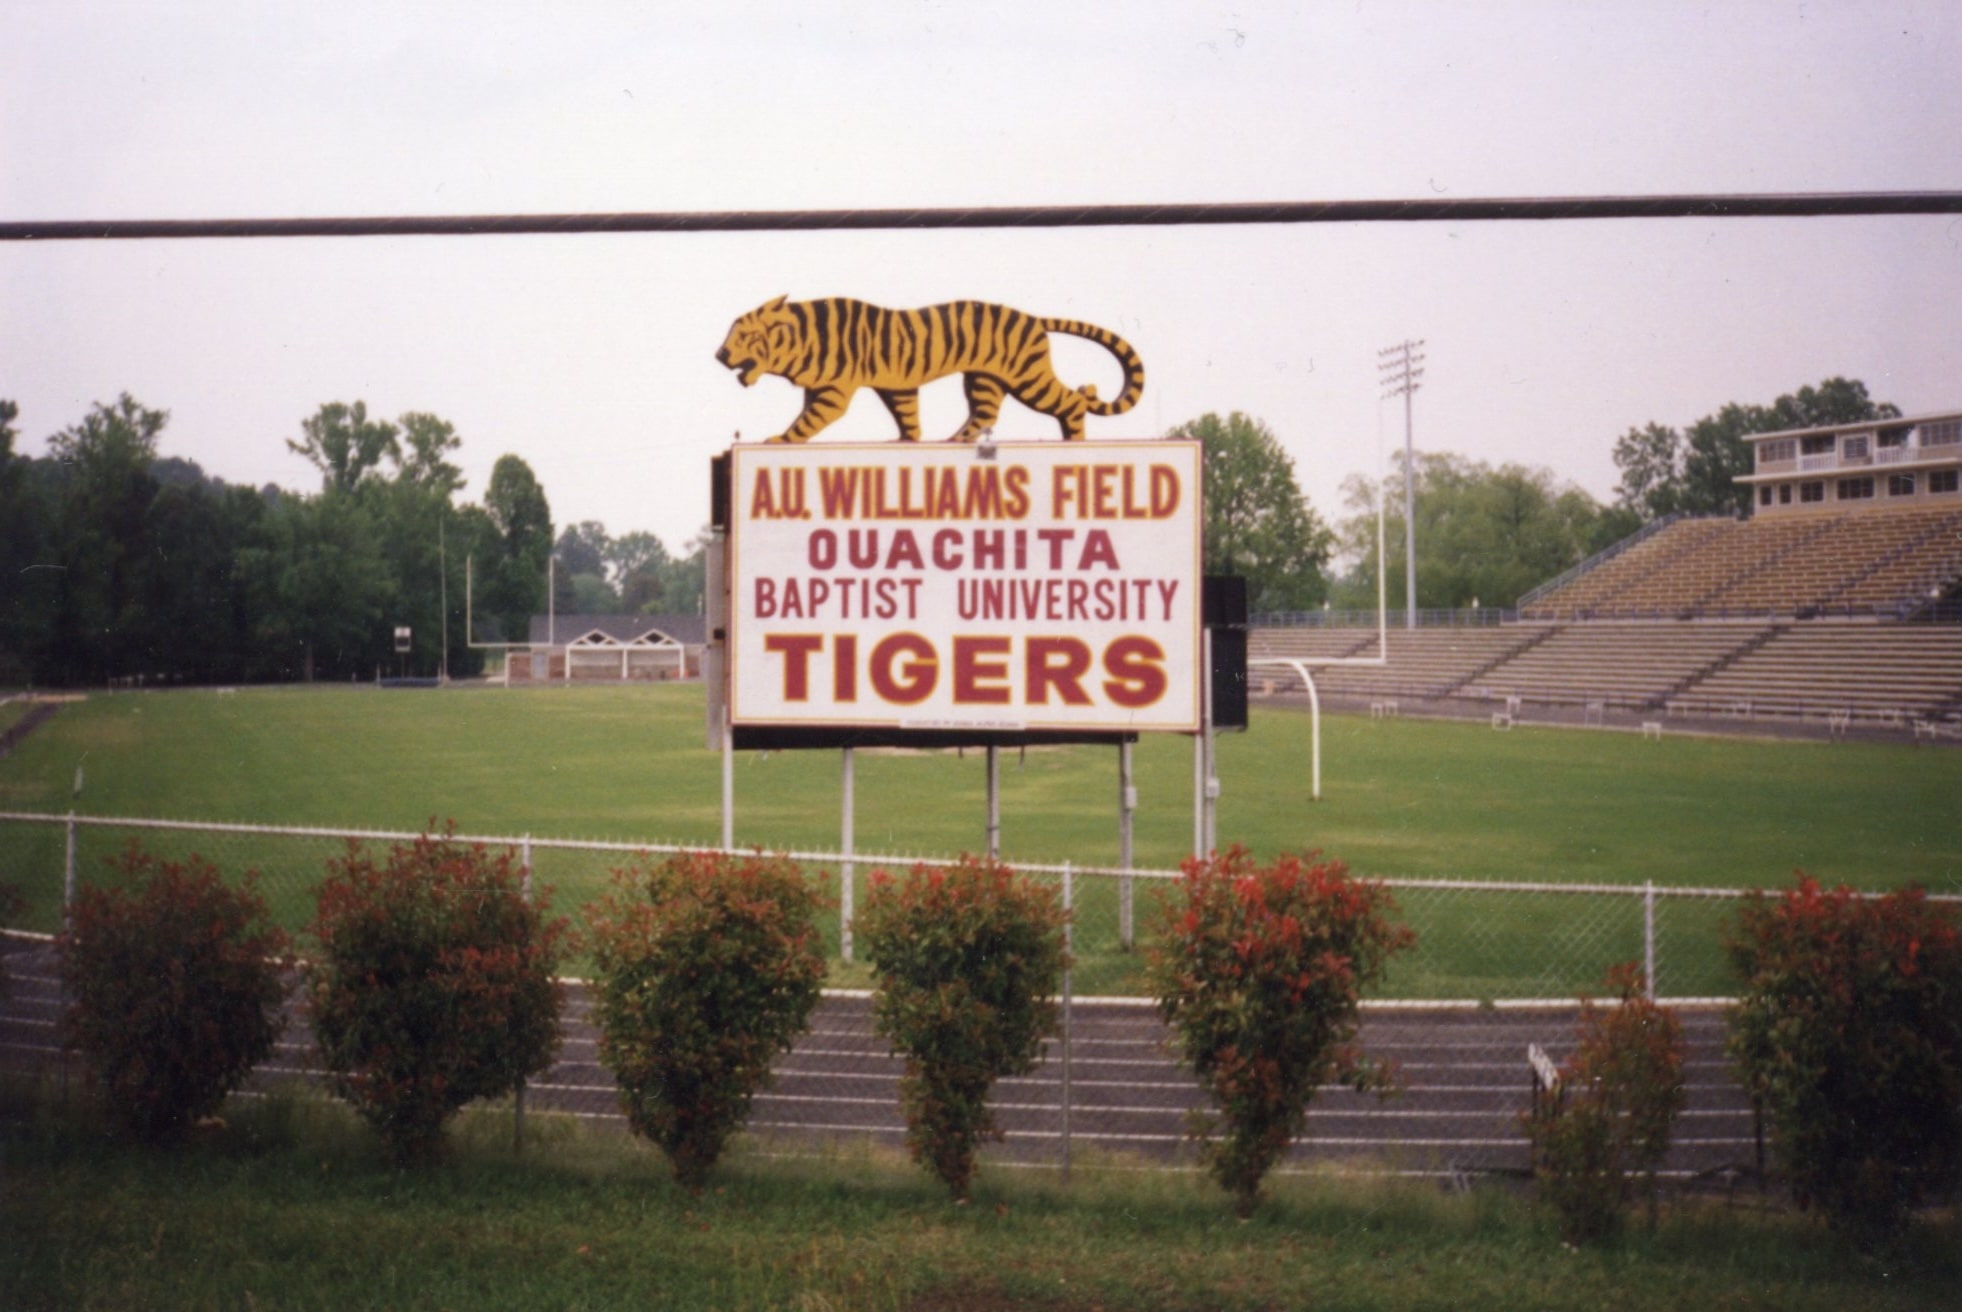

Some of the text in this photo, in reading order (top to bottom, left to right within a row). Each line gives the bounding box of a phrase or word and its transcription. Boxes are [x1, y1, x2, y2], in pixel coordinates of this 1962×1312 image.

[750, 463, 1182, 520] A.U. WILLIAMS FIELD
[807, 528, 1120, 571] OUACHITA
[754, 577, 1179, 622] BAPTIST UNIVERSITY
[763, 631, 1168, 709] TIGERS
